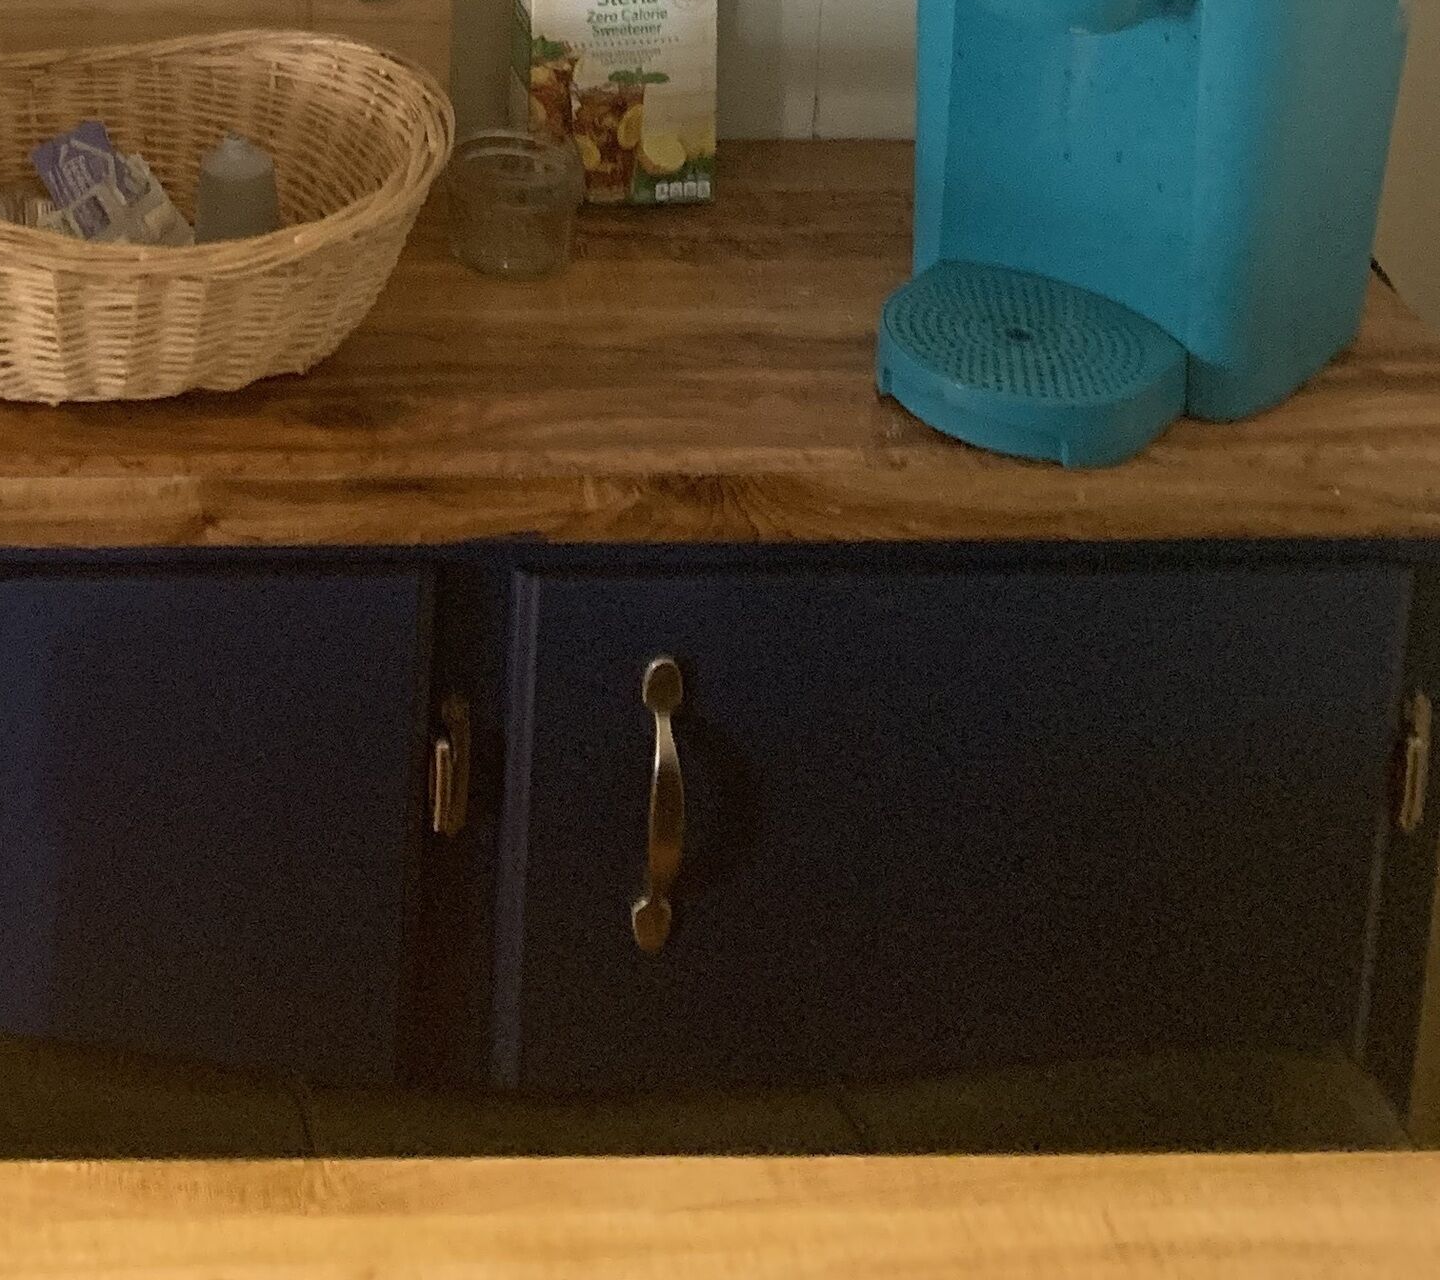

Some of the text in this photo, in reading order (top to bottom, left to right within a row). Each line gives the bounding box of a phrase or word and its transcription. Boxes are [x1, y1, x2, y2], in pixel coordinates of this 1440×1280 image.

[586, 7, 668, 25] Zero Calorie
[591, 24, 662, 38] Sweetener
